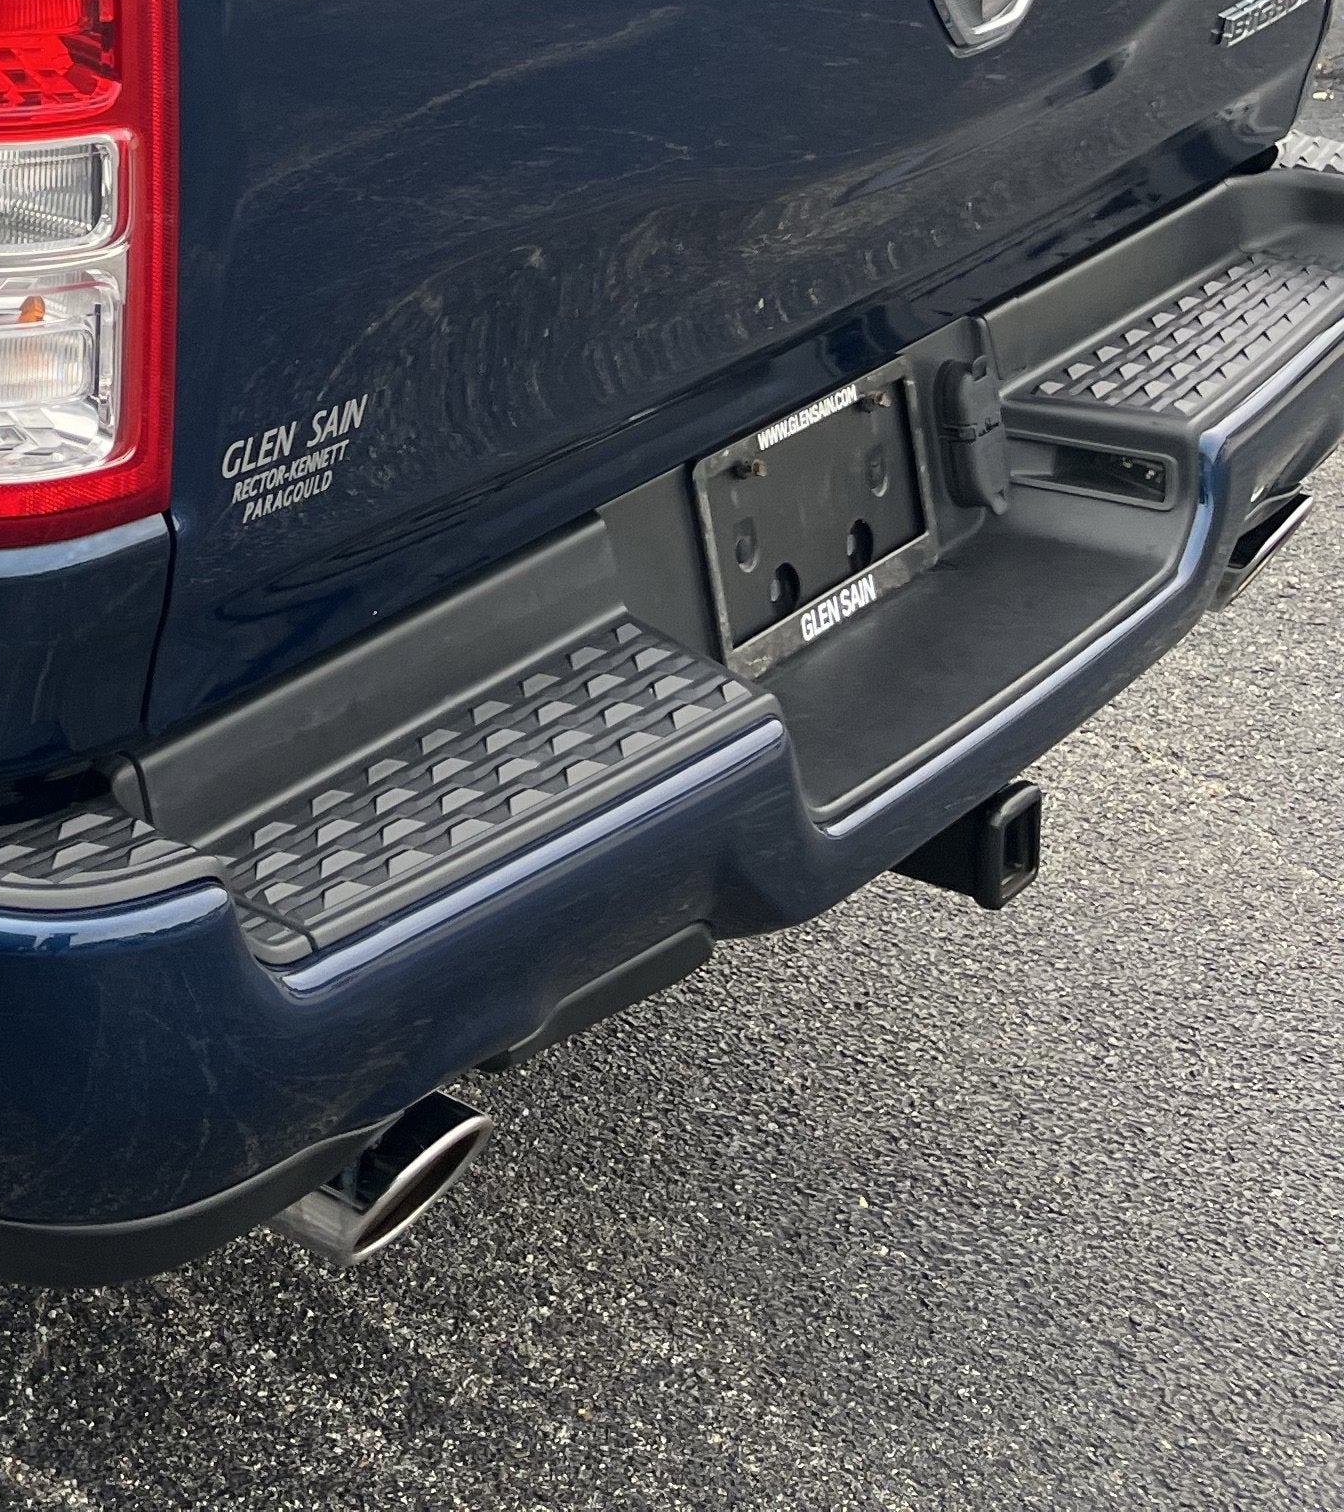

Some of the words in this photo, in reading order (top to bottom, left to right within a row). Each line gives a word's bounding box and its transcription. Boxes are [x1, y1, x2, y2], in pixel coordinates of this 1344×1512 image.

[221, 420, 298, 479] GLEN
[306, 393, 369, 448] SAIN
[757, 383, 858, 451] WWW.GLENSAIN.COM
[231, 439, 350, 505] RECTOR-KENNETT
[242, 469, 333, 525] PARAGOULD
[800, 595, 841, 642] GLEN
[839, 573, 877, 617] SAIN
